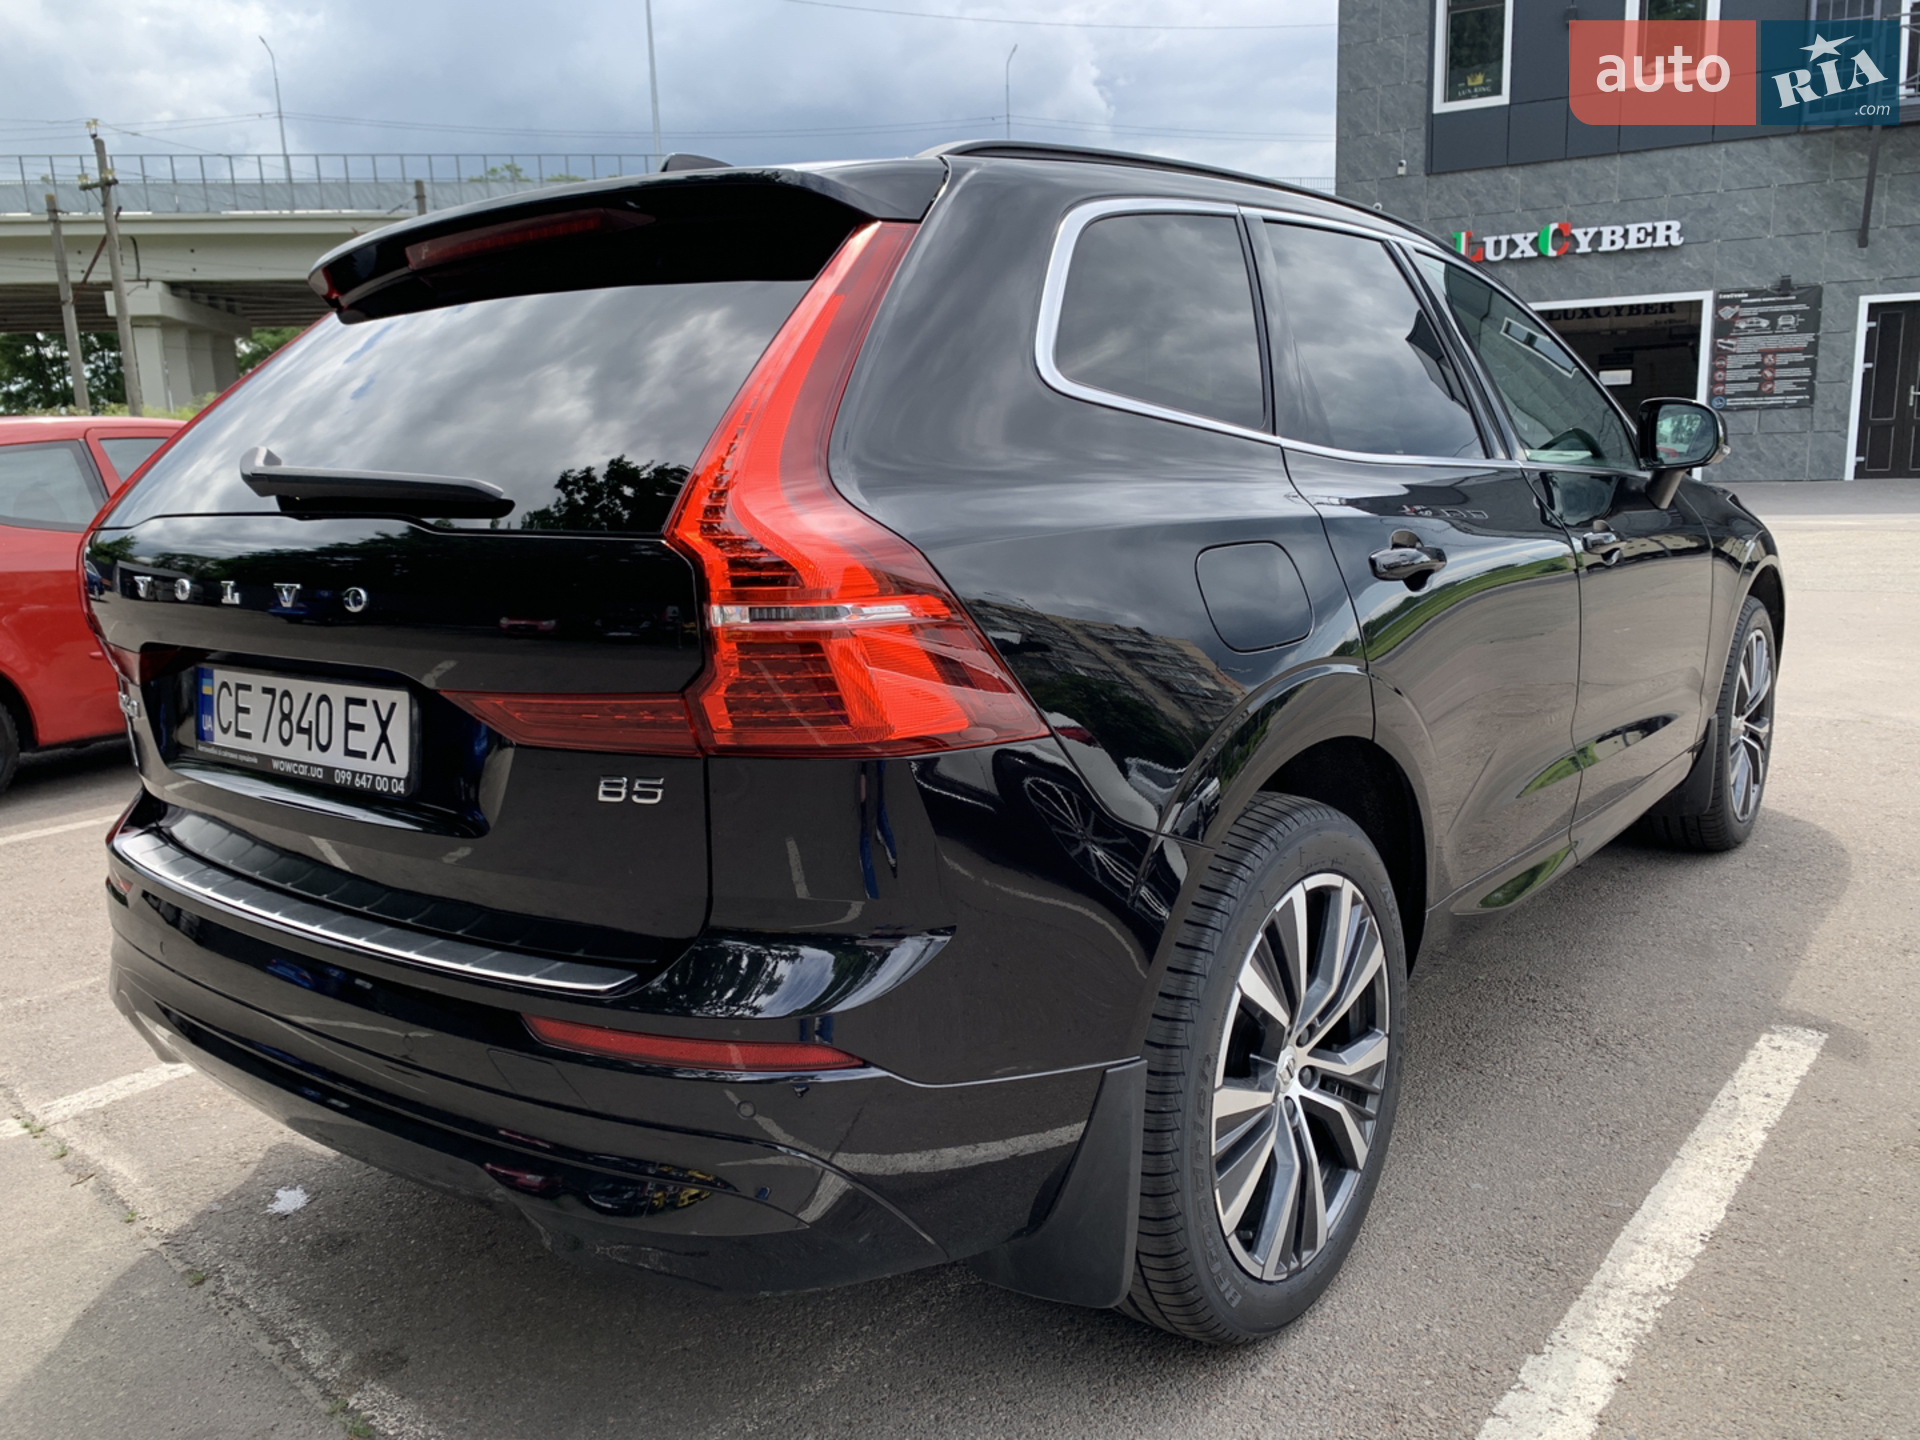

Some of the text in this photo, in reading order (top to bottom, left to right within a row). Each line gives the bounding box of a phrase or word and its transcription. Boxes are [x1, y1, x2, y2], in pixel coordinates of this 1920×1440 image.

[133, 575, 369, 613] VOLVO
[202, 714, 213, 731] UA
[216, 680, 253, 740] CE
[260, 686, 334, 754] 7840
[343, 696, 398, 765] EX
[271, 758, 405, 794] wowcar.ua 099 647 00 04
[597, 776, 665, 804] B5
